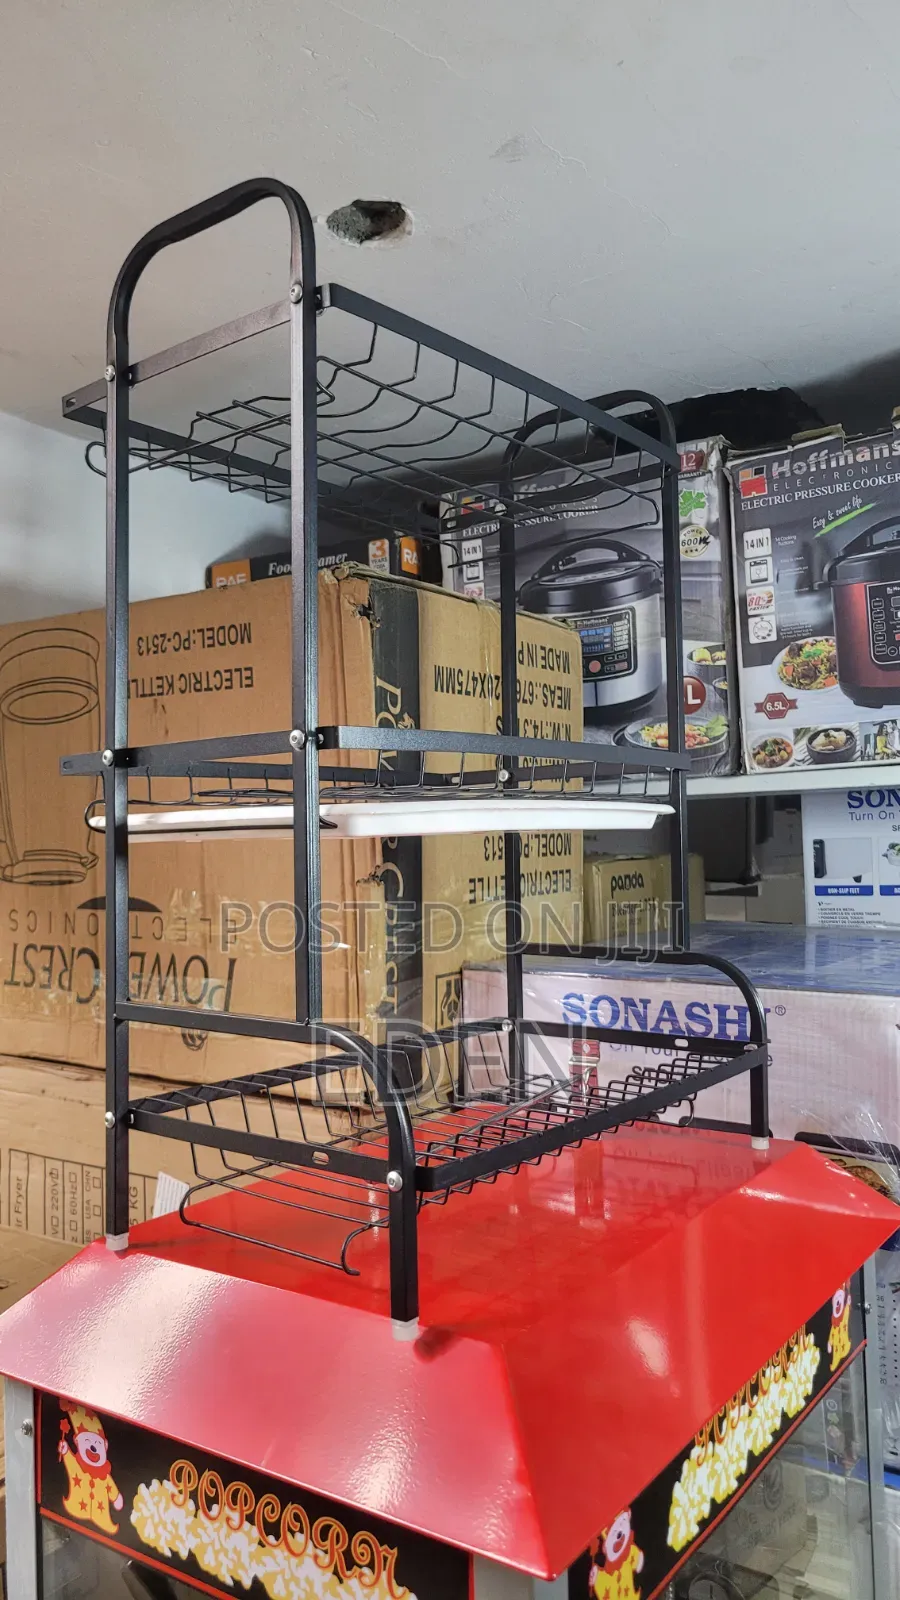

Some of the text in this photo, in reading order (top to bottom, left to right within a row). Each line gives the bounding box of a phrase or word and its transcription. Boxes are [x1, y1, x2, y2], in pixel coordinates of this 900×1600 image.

[681, 453, 696, 467] 12
[741, 474, 900, 511] ELECTRIC PRESSURE COOKER
[827, 510, 834, 521] &
[835, 503, 851, 517] sweet
[463, 523, 500, 537] ELECTRI
[745, 536, 769, 550] 14 IN 1
[136, 622, 253, 657] MODEL:PC-2513
[527, 642, 538, 666] IN
[539, 645, 571, 675] MADE
[128, 666, 254, 699] ELECTRIC KETTL
[765, 701, 786, 711] 6.5L
[848, 810, 895, 821] Turn On
[469, 868, 572, 905] ELECTRIC ETTLE
[610, 870, 645, 899] panda
[8, 908, 238, 945] ELECTONICS
[14, 1176, 26, 1214] Fryer
[69, 1184, 77, 1215] 60Hz
[129, 1186, 138, 1210] KG
[168, 1458, 412, 1600] POPCORN
